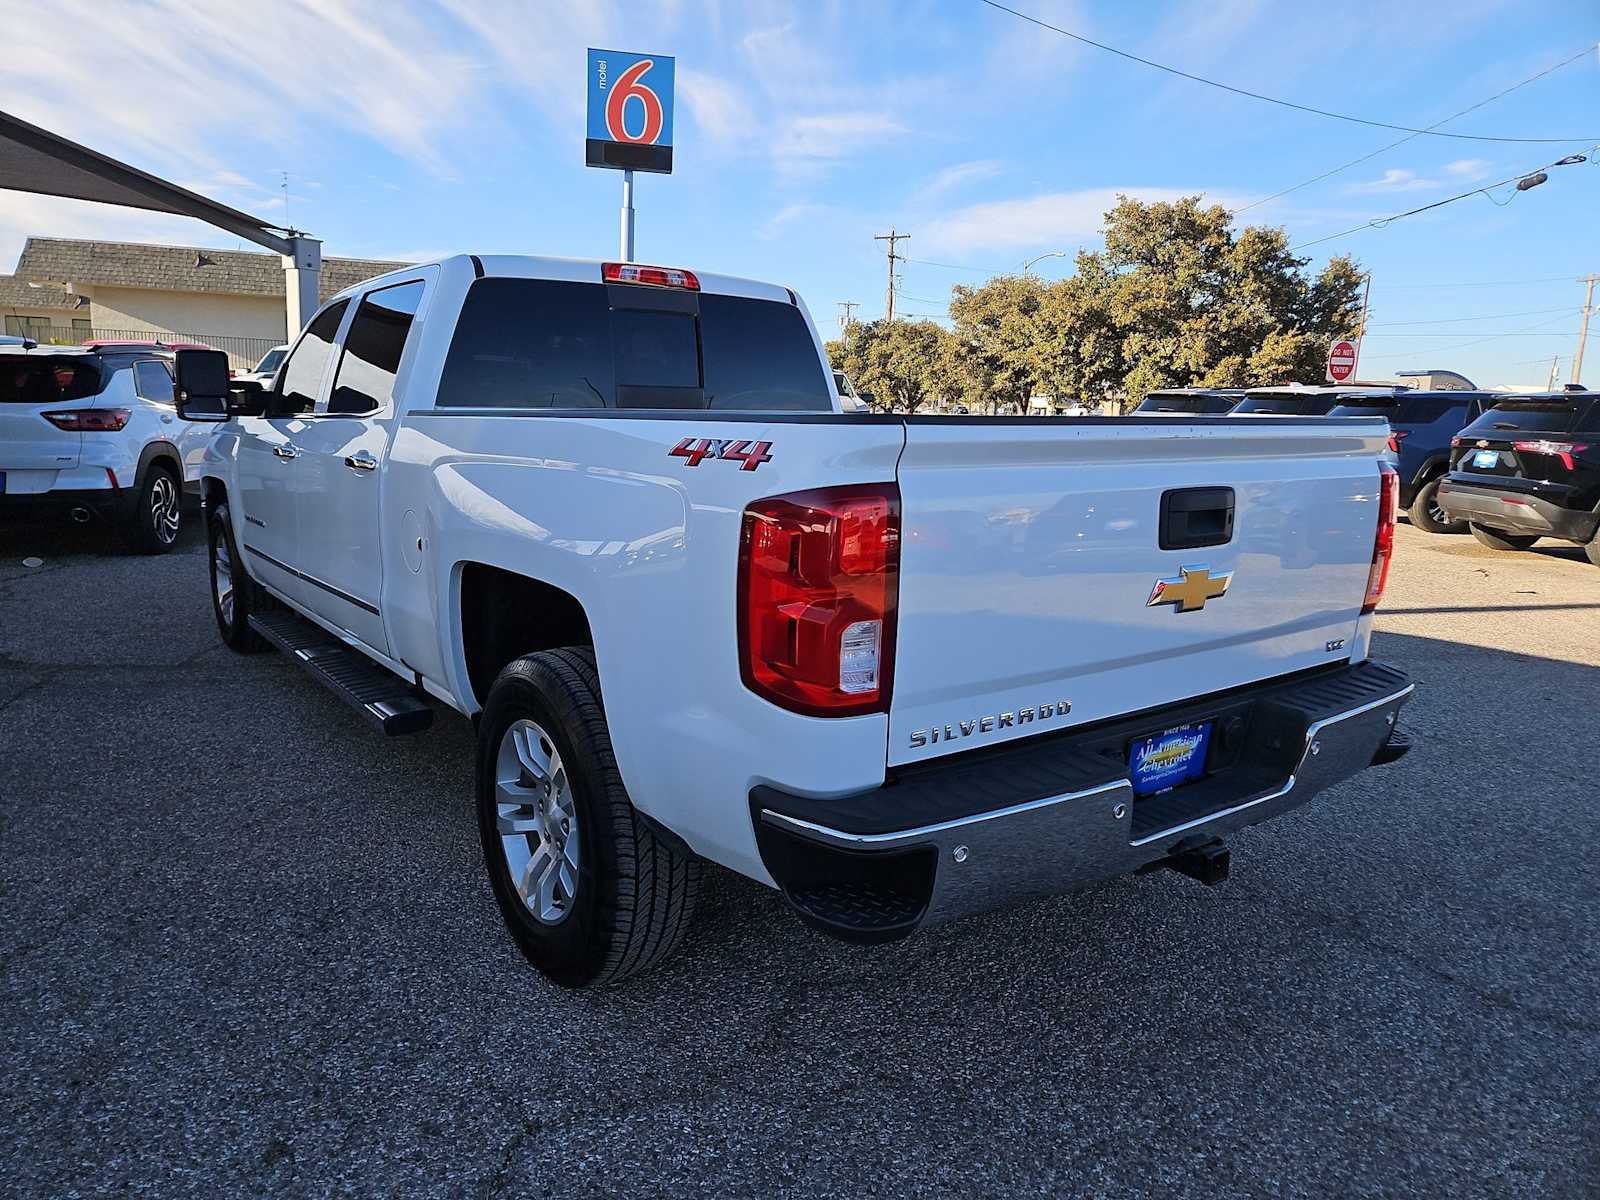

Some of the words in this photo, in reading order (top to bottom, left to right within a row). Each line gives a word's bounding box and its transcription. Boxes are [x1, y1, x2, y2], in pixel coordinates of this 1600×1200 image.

[597, 60, 607, 89] motel
[605, 59, 663, 145] 6
[1333, 348, 1341, 356] DO
[1343, 348, 1352, 356] NOT
[1333, 366, 1349, 374] ENTER
[910, 700, 1072, 748] SILVERADO
